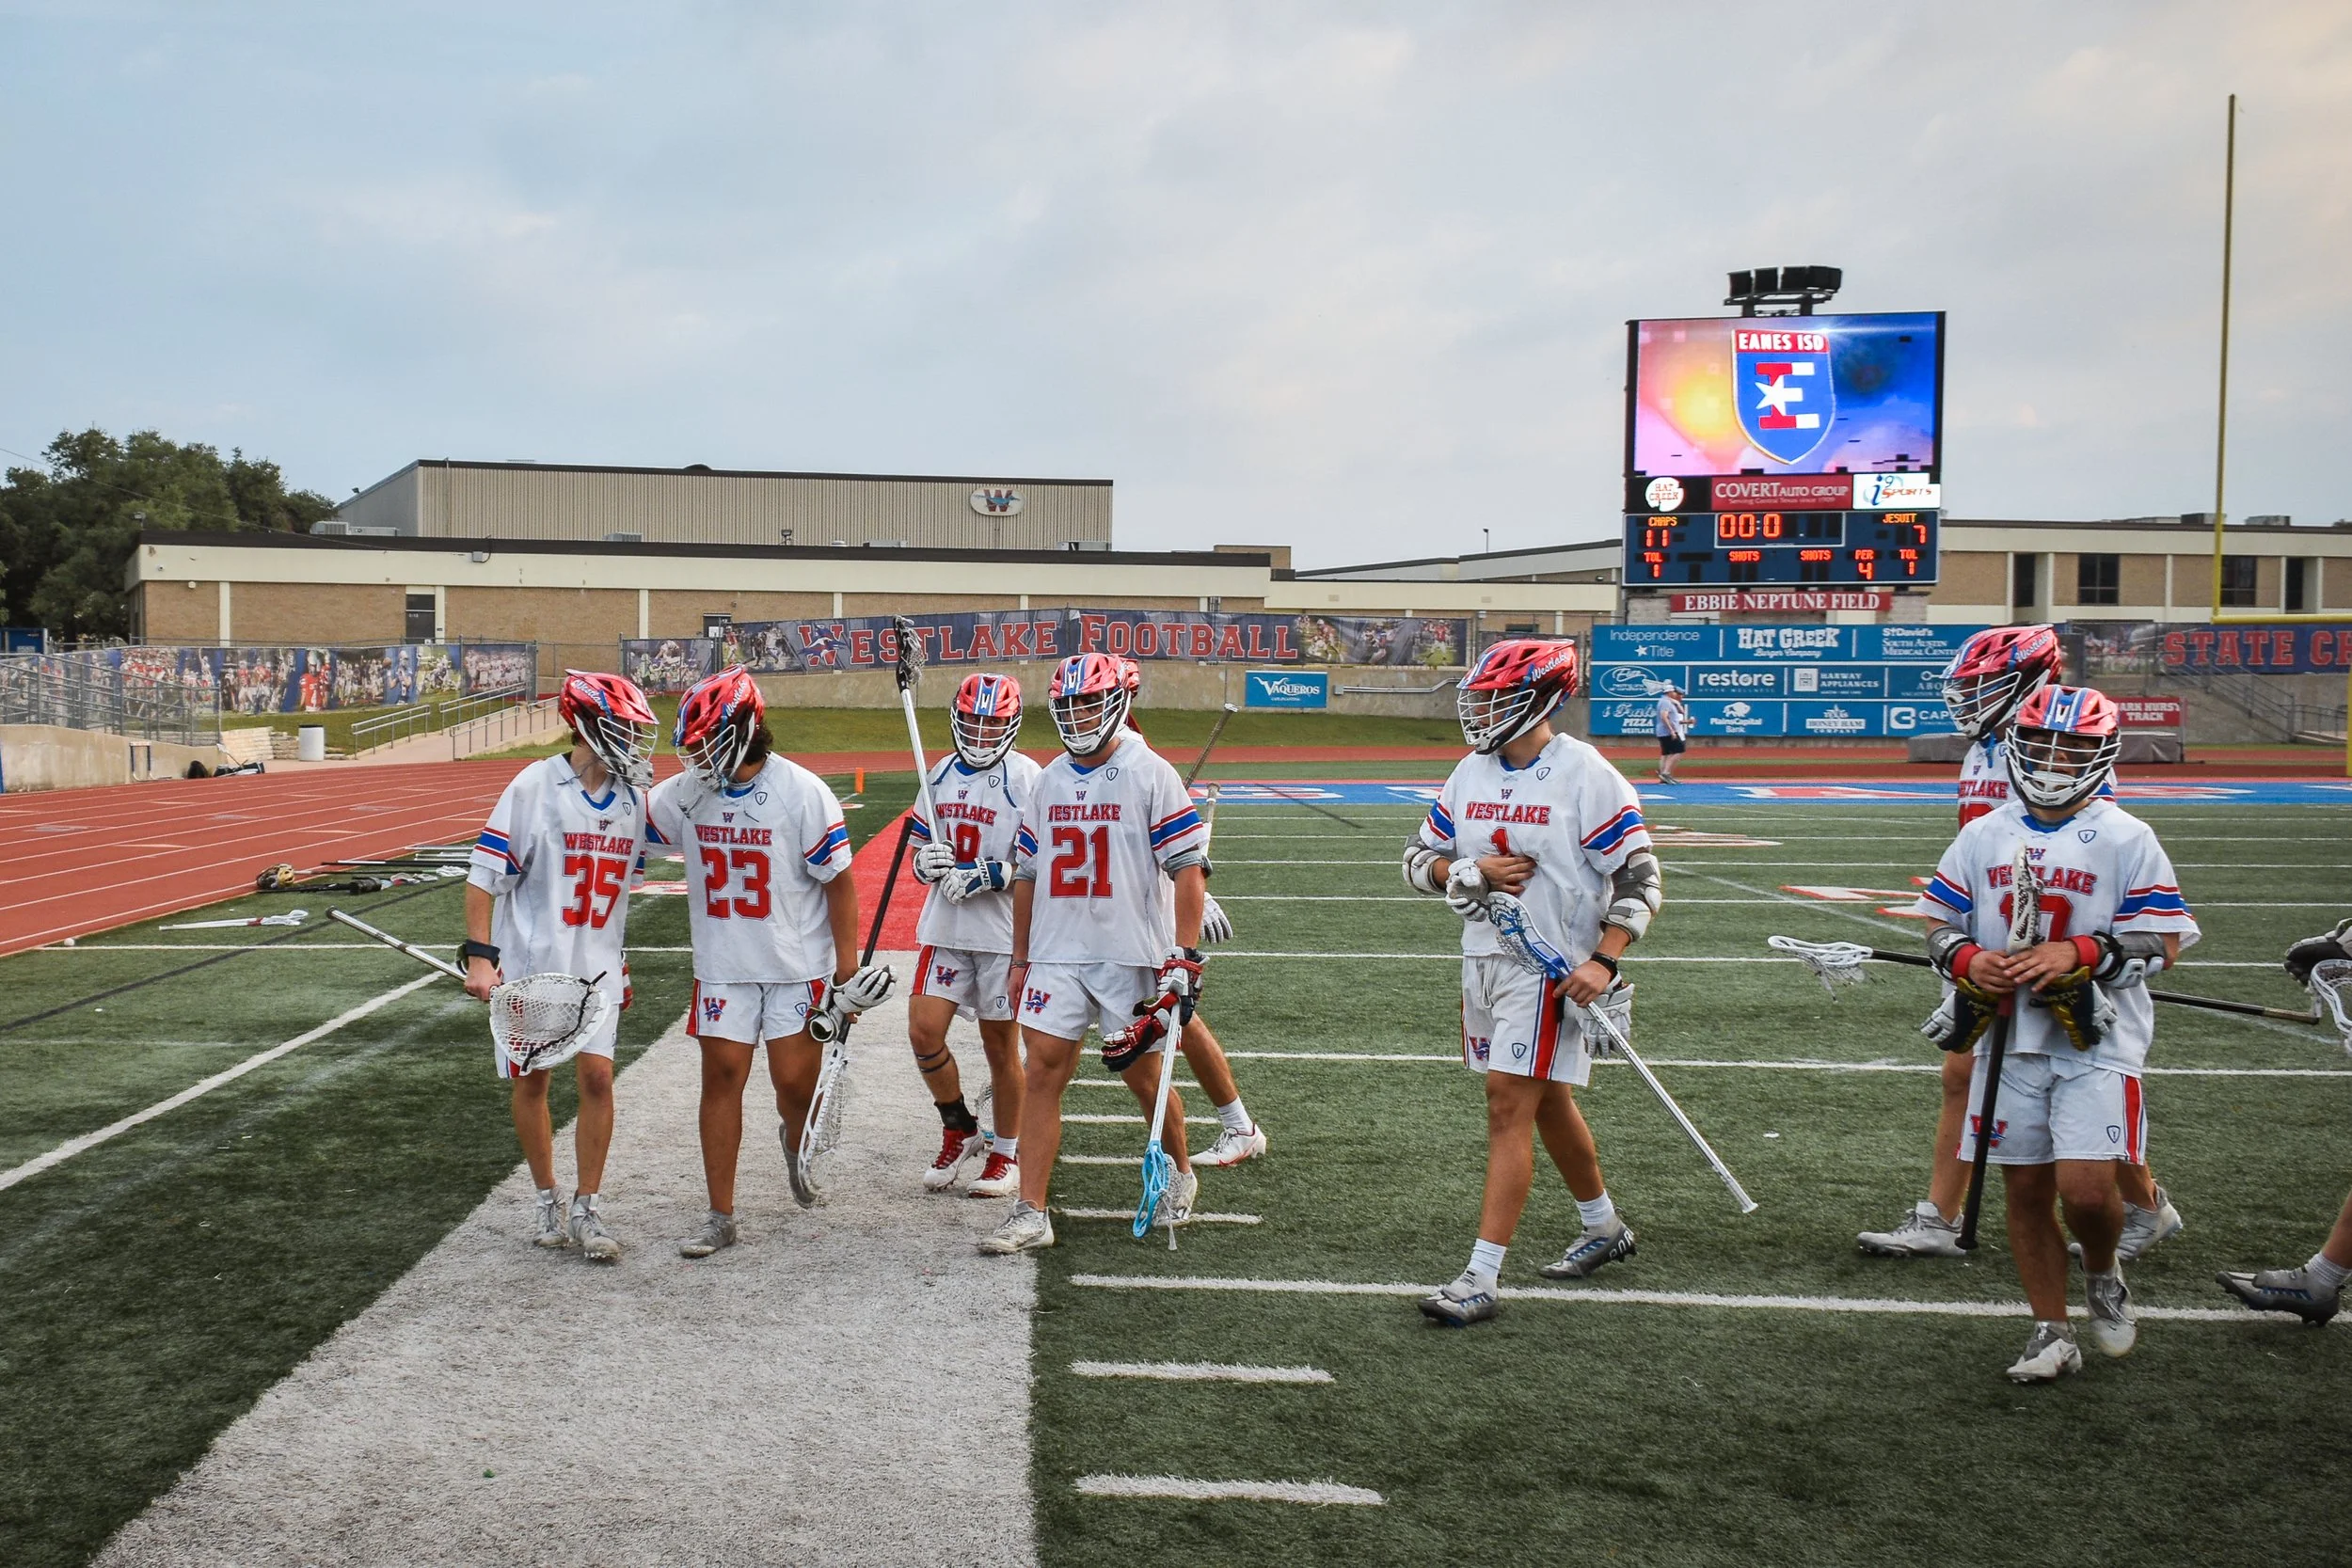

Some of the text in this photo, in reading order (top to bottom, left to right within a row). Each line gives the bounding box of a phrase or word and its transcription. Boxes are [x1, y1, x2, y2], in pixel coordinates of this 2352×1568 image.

[1739, 333, 1824, 351] EANES ISD
[1655, 483, 1674, 492] HAT
[1715, 483, 1849, 498] COVERT AUTO GROUP
[1649, 492, 1679, 501] CREEK
[1648, 516, 1677, 527] CHAPS
[1883, 513, 1917, 524] JESUIT
[1646, 529, 1670, 547] 11
[1913, 525, 1926, 544] 7
[1644, 551, 1663, 562] TOL
[1728, 550, 1761, 562] SHOTS
[1800, 549, 1832, 561] SHOTS
[1854, 548, 1874, 560] PER
[1899, 548, 1918, 560] TOL
[1653, 563, 1661, 578] 1
[1858, 562, 1873, 580] 4
[1908, 561, 1915, 576] 1
[1685, 594, 1880, 610] EBBIE NEPTUNE FIELD
[1078, 613, 1297, 659] FOOTBALL
[1610, 629, 1700, 642] Independence
[1737, 627, 1840, 649] HAT CREEK
[1883, 639, 1913, 647] SOUTH
[1649, 645, 1675, 657] Title
[1883, 647, 1961, 656] MEDICAL CENTE
[2164, 631, 2295, 666] STATE
[1698, 670, 1776, 687] restore
[1253, 676, 1321, 697] VAQUEROS
[2115, 702, 2143, 712] ARK
[1622, 718, 1655, 727] PIZZA
[1919, 710, 1950, 721] CAP
[2126, 712, 2165, 721] TRACK
[935, 802, 998, 827] WSTLAKE
[563, 832, 634, 856] WESTLAKE
[1050, 824, 1113, 898] 21
[698, 845, 772, 921] 23
[561, 853, 628, 930] 35
